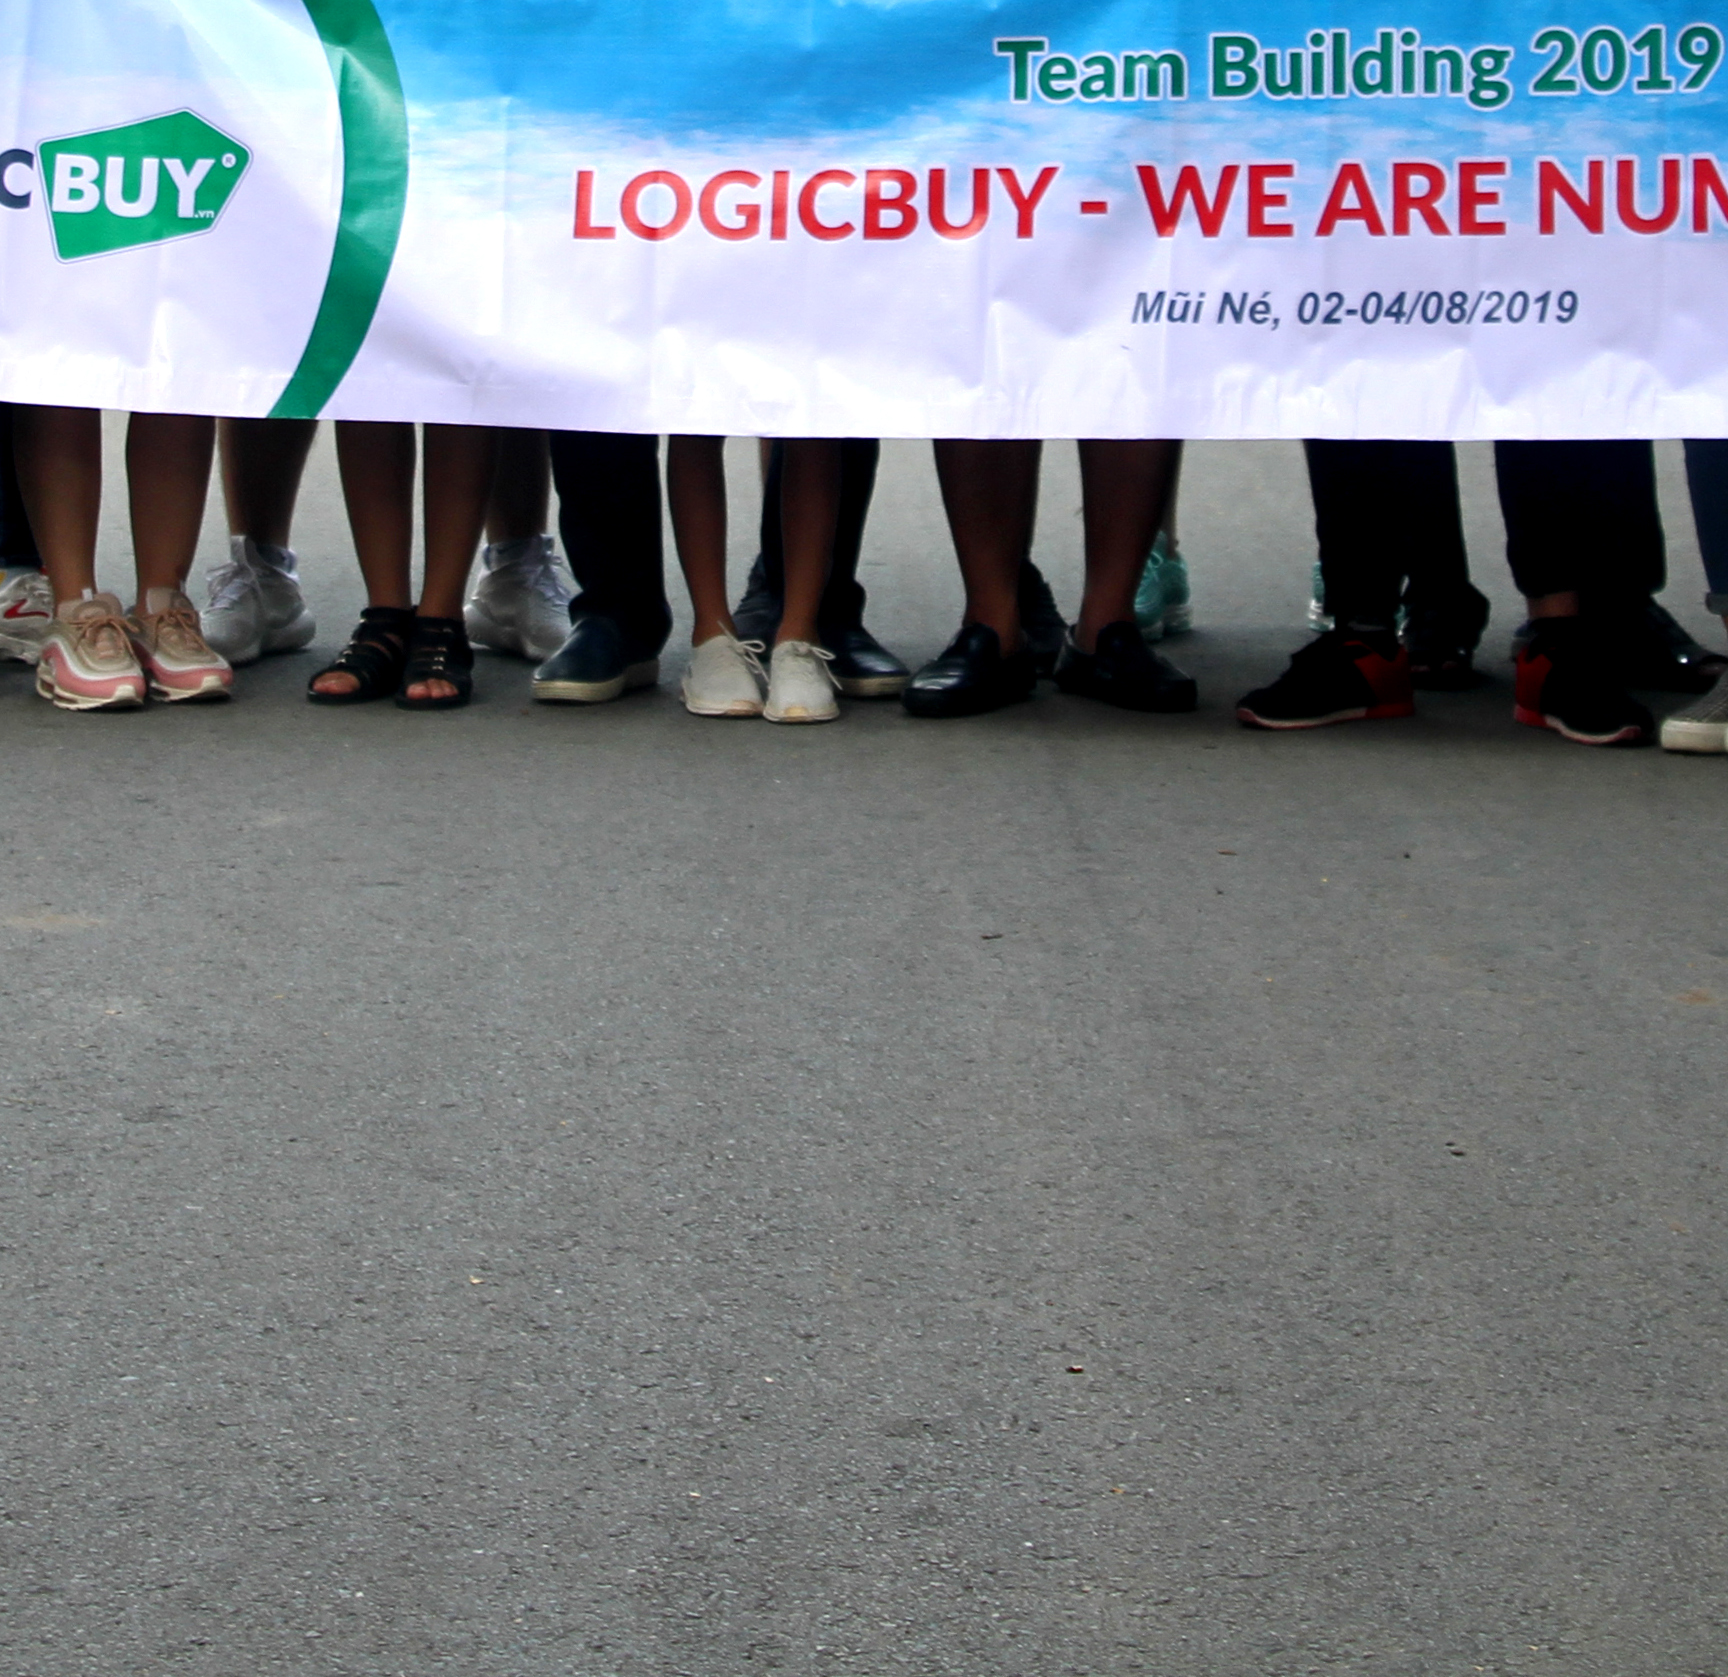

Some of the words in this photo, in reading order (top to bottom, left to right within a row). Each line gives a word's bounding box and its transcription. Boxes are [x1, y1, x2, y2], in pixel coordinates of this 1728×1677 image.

[995, 37, 1188, 103] Team
[1209, 28, 1512, 109] Building
[1529, 23, 1724, 95] 2019
[571, 164, 1060, 241] LOGICBUY
[1136, 162, 1296, 239] WE
[1315, 160, 1508, 238] ARE
[1130, 290, 1206, 324] Mũi
[1216, 291, 1280, 332] Né,
